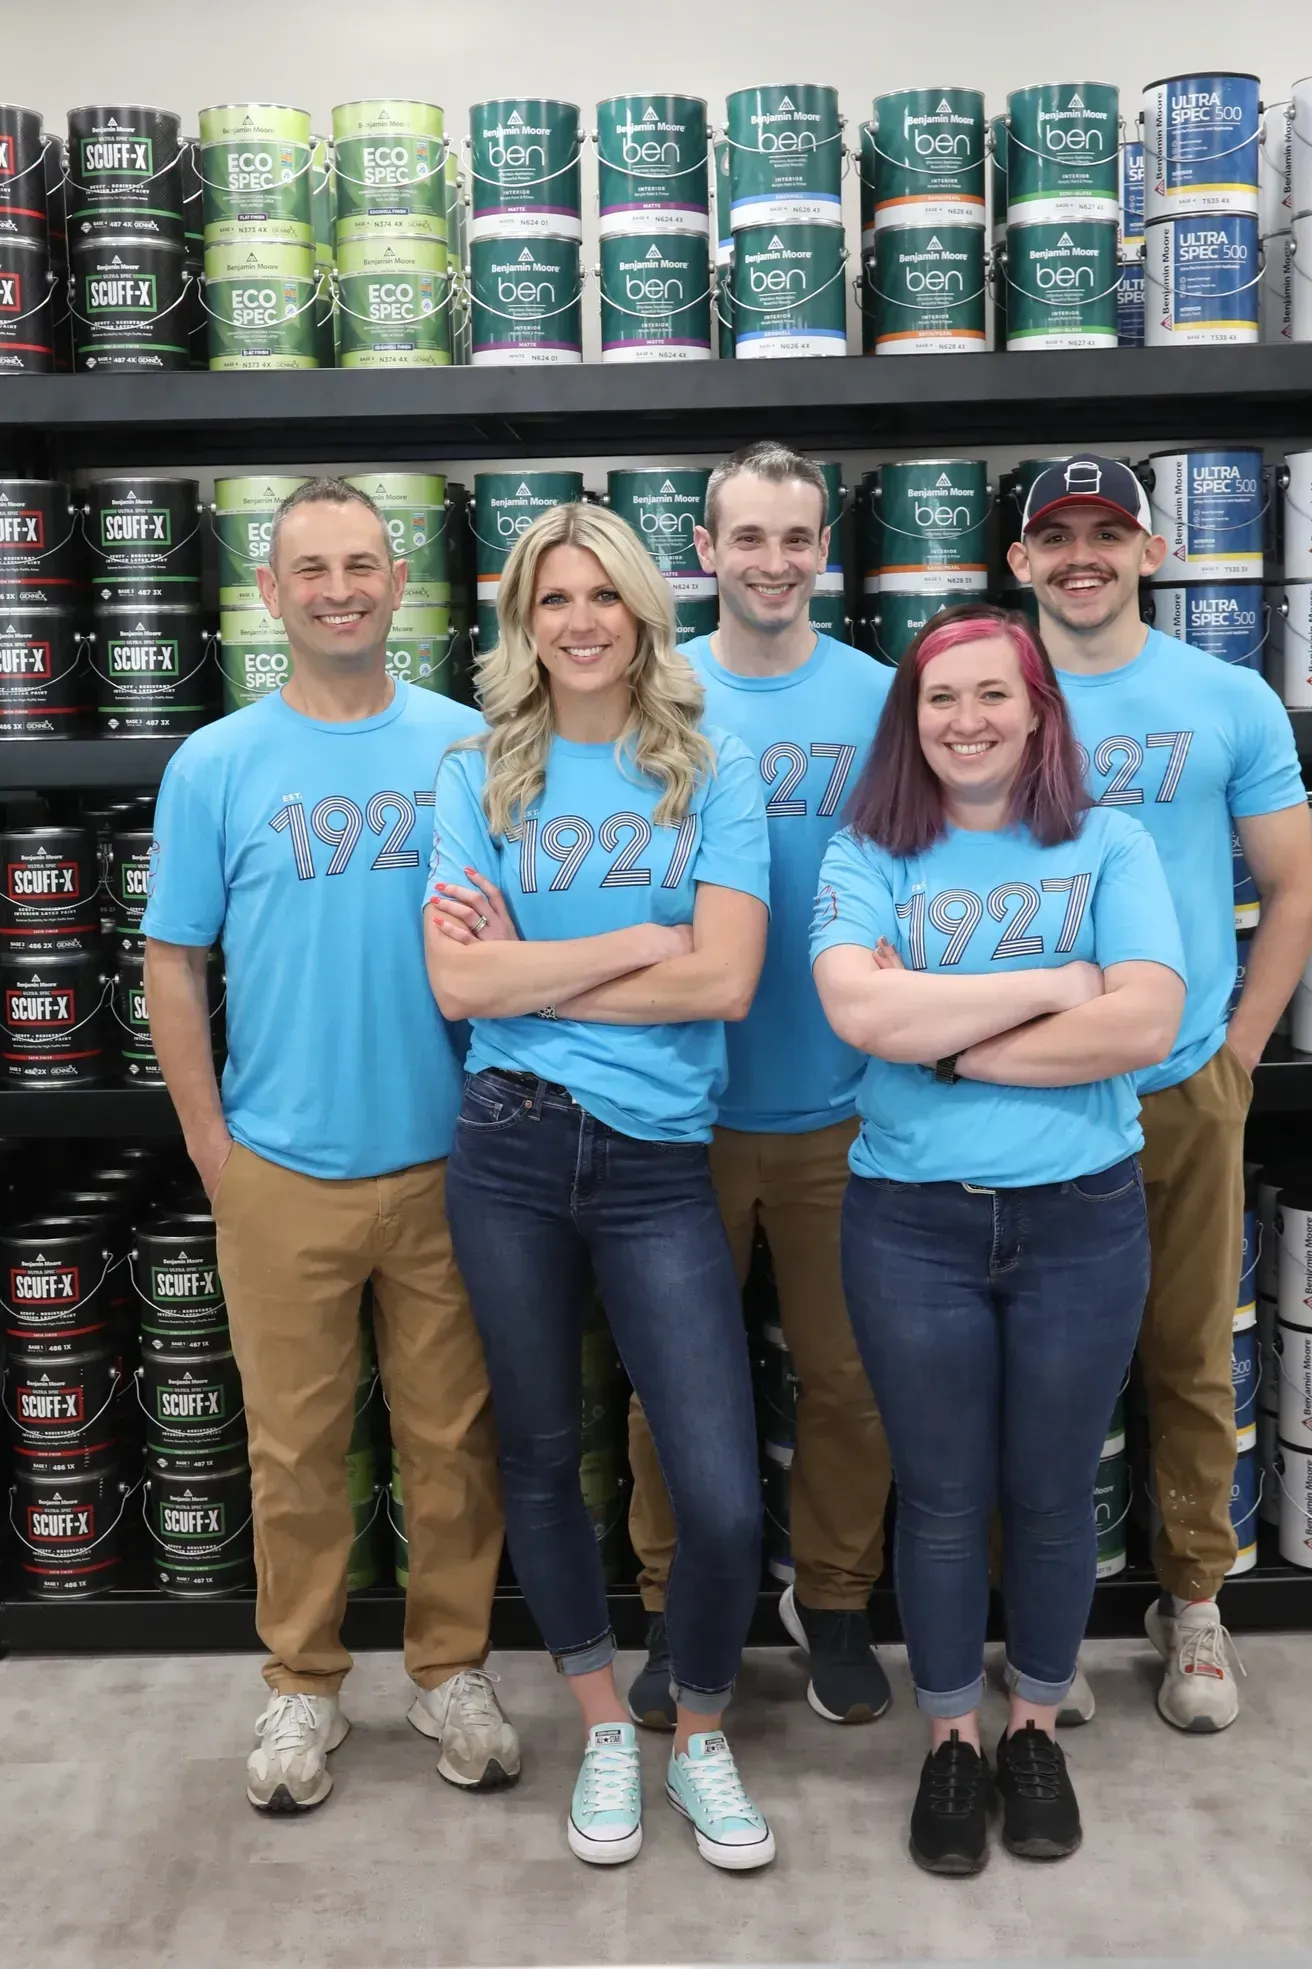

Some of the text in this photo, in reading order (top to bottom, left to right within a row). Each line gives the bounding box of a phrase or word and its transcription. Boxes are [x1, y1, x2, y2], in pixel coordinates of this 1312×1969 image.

[1171, 93, 1220, 110] ULTRA
[751, 112, 821, 125] Benjamin Moore
[907, 115, 975, 126] Benjamin Moore
[1039, 111, 1108, 121] Benjamin Moore
[1172, 106, 1242, 124] SPEC 500
[483, 126, 552, 138] Benjamin Moore
[617, 122, 686, 134] Benjamin Moore
[1046, 125, 1102, 151] ben
[623, 138, 680, 163] ben
[758, 131, 816, 152] ben
[915, 129, 970, 155] ben
[86, 144, 146, 169] SCUFF-X
[228, 153, 273, 173] ECO
[363, 147, 409, 167] ECO
[489, 142, 545, 167] ben
[1156, 129, 1164, 180] Benjamin
[228, 173, 273, 189] SPEC
[364, 167, 409, 183] SPEC
[1180, 231, 1228, 247] ULTRA
[745, 251, 813, 263] Benjamin Moore
[899, 252, 968, 263] Benjamin Moore
[1030, 248, 1099, 260] Benjamin Moore
[1180, 245, 1247, 260] SPEC 500
[492, 263, 560, 274] Benjamin Moore
[620, 260, 689, 271] Benjamin Moore
[1036, 263, 1094, 288] ben
[498, 277, 555, 302] ben
[626, 275, 682, 299] ben
[750, 267, 806, 292] ben
[906, 267, 963, 292] ben
[91, 281, 150, 306] SCUFF-X
[232, 289, 277, 308] ECO
[368, 284, 414, 303] ECO
[233, 309, 277, 324] SPEC
[370, 304, 414, 319] SPEC
[1193, 466, 1240, 480] ULTRA
[908, 488, 975, 498] Benjamin Moore
[1193, 479, 1257, 493] SPEC 500
[491, 498, 558, 507] Benjamin Moore
[633, 495, 700, 504] Benjamin Moore
[640, 509, 696, 533] ben
[915, 502, 969, 526] ben
[1175, 503, 1183, 545] Benjamin
[106, 516, 164, 540] SCUFF-X
[1173, 593, 1181, 630] Moore
[1191, 599, 1238, 613] ULTRA
[1191, 612, 1255, 626] SPEC 500
[114, 647, 172, 670] SCUFF-X
[245, 654, 288, 672] ECO
[246, 672, 288, 687] SPEC
[1094, 731, 1193, 807] 27
[760, 742, 856, 818] 27
[505, 811, 697, 894] 1927
[14, 869, 73, 893] SCUFF-X
[895, 873, 1092, 970] 1927
[12, 997, 68, 1020] SCUFF-X
[16, 1274, 73, 1298] SCUFF-X
[157, 1273, 214, 1296] SCUFF-X
[1303, 1339, 1311, 1369] Moore
[22, 1394, 78, 1418] SCUFF-X
[163, 1392, 219, 1416] SCUFF-X
[33, 1512, 88, 1536] SCUFF-X
[165, 1510, 219, 1533] SCUFF-X
